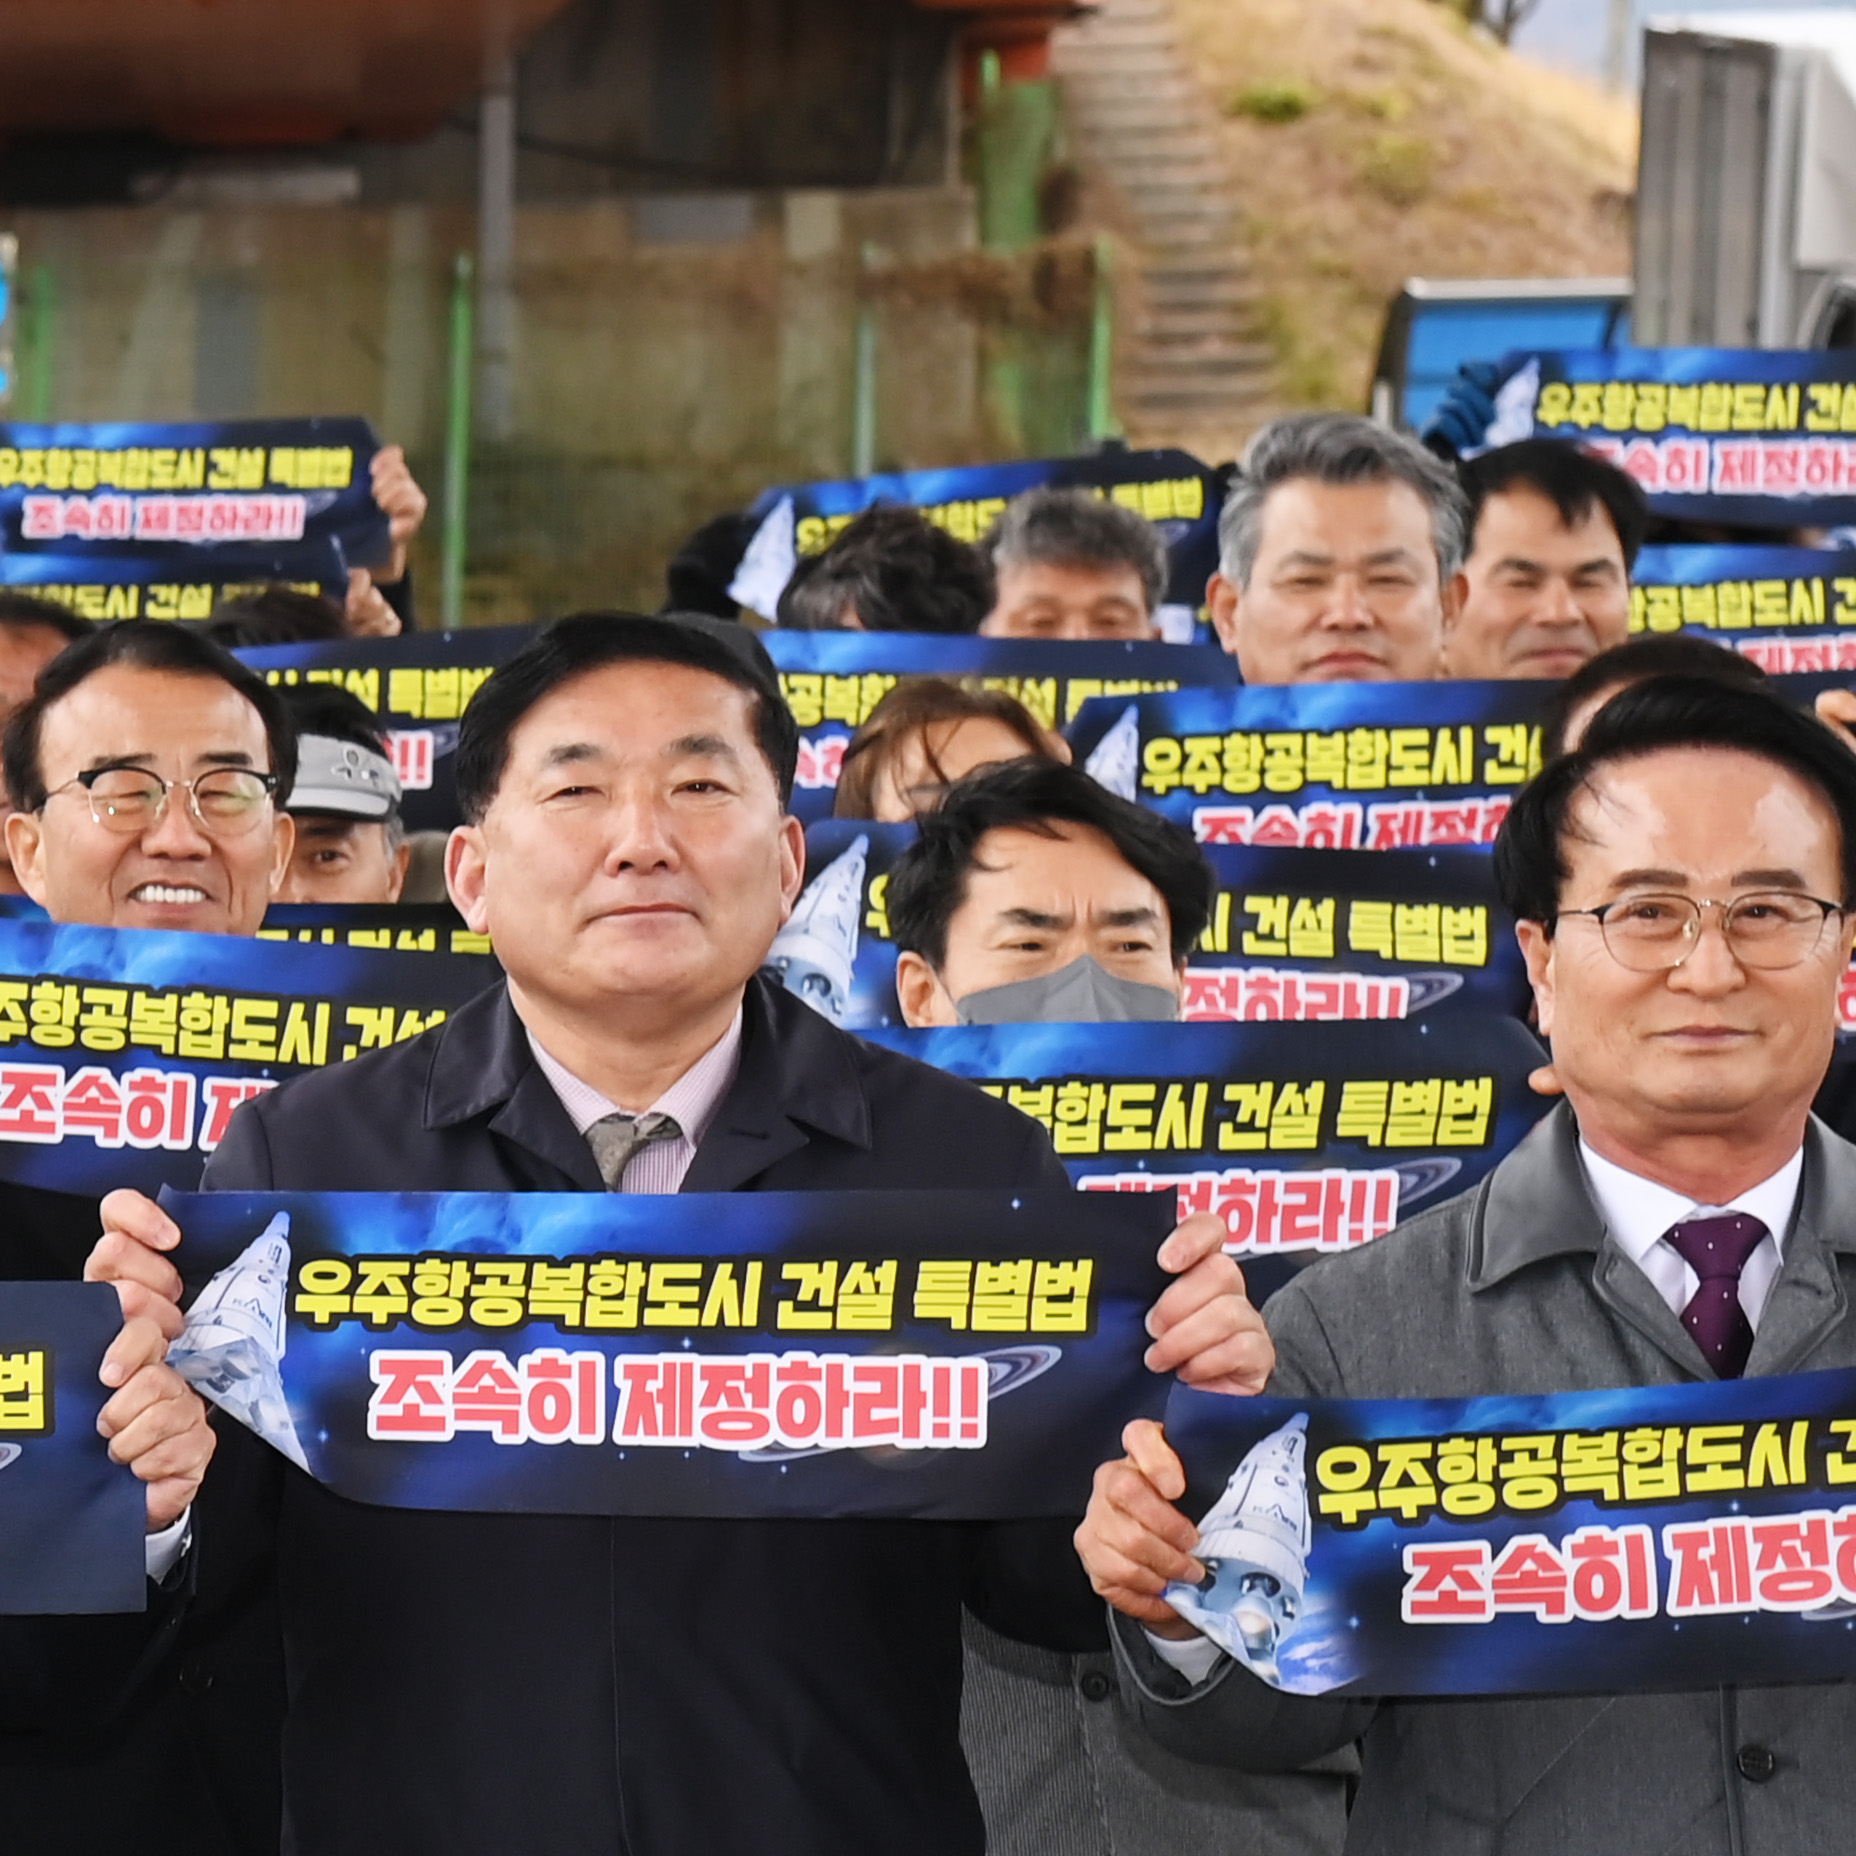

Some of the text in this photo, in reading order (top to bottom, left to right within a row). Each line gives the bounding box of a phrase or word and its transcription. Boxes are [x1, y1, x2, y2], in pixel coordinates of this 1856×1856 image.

[1537, 382, 1800, 432] 우주항공복합도시
[1141, 725, 1474, 795] 우주항공복합도시
[1244, 895, 1336, 958] 건설
[1350, 900, 1488, 966] 특별법
[1220, 1080, 1325, 1151] 건설
[1337, 1076, 1493, 1147] 특별법
[297, 1258, 1093, 1332] 우주항공복합도시 건설 특별법
[374, 1354, 982, 1444] 조속히 제정하라!!
[1317, 1420, 1809, 1524] 우주항공복합도시
[1408, 1530, 1652, 1618] 조속히
